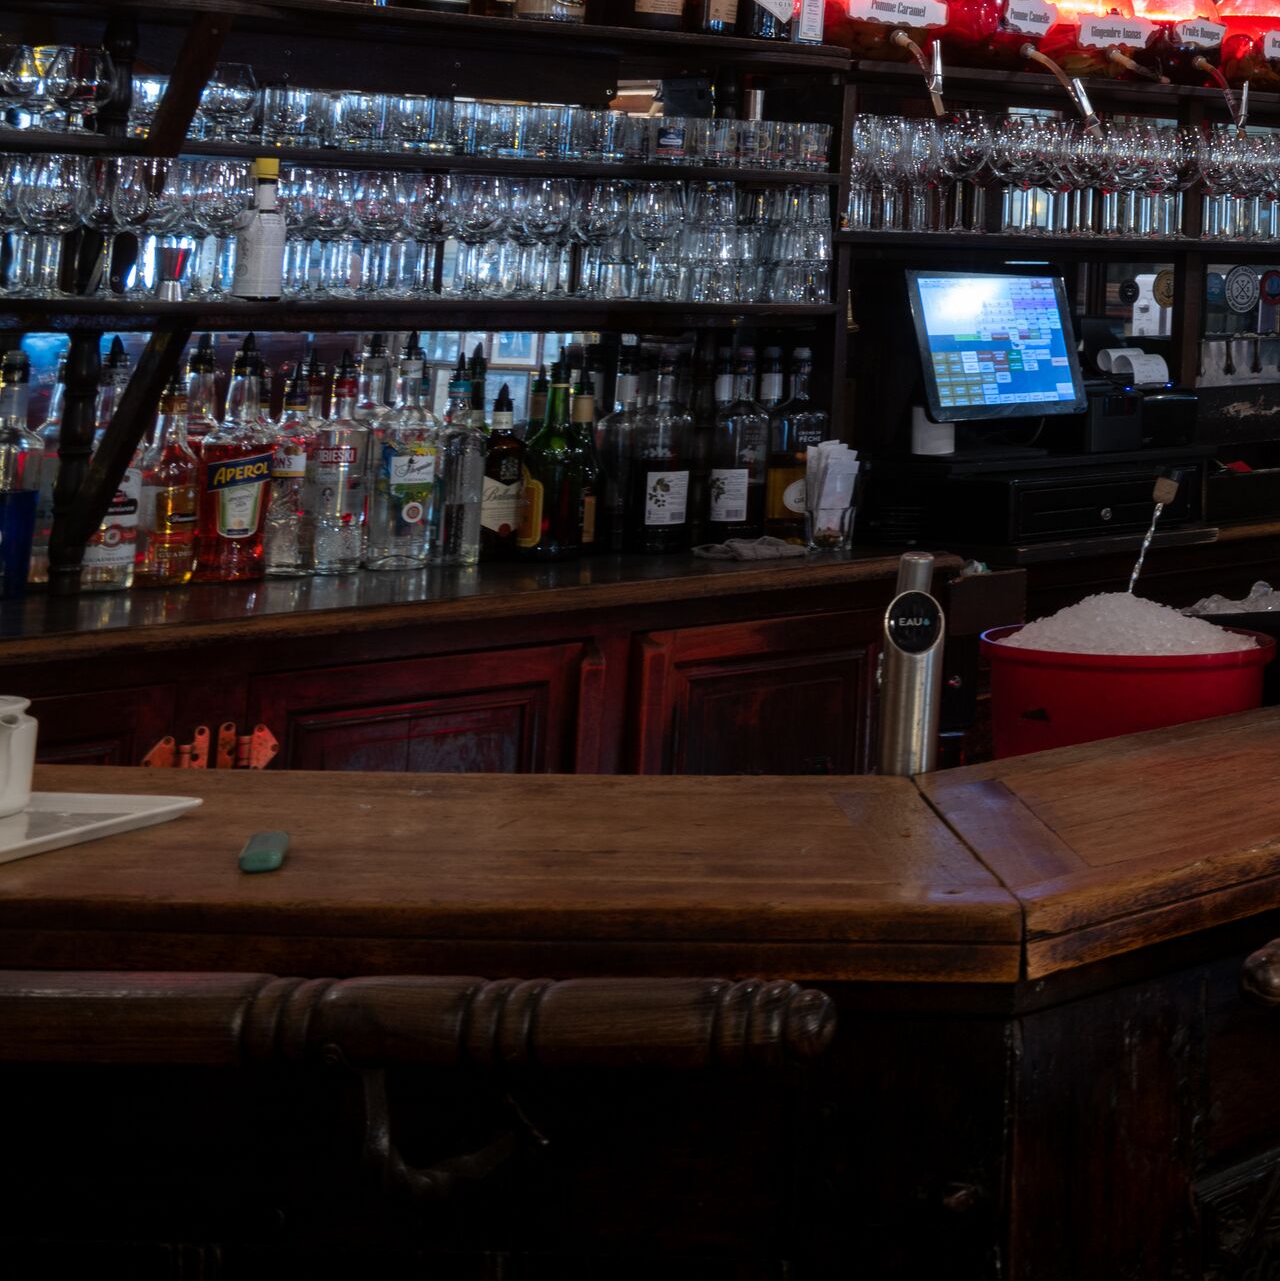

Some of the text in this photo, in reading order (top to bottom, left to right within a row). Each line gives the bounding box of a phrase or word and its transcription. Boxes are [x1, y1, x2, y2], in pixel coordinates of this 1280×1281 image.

[899, 1, 927, 18] Caramel
[1182, 24, 1200, 38] Fruits
[213, 461, 270, 486] APEROL
[899, 617, 924, 626] EAU
